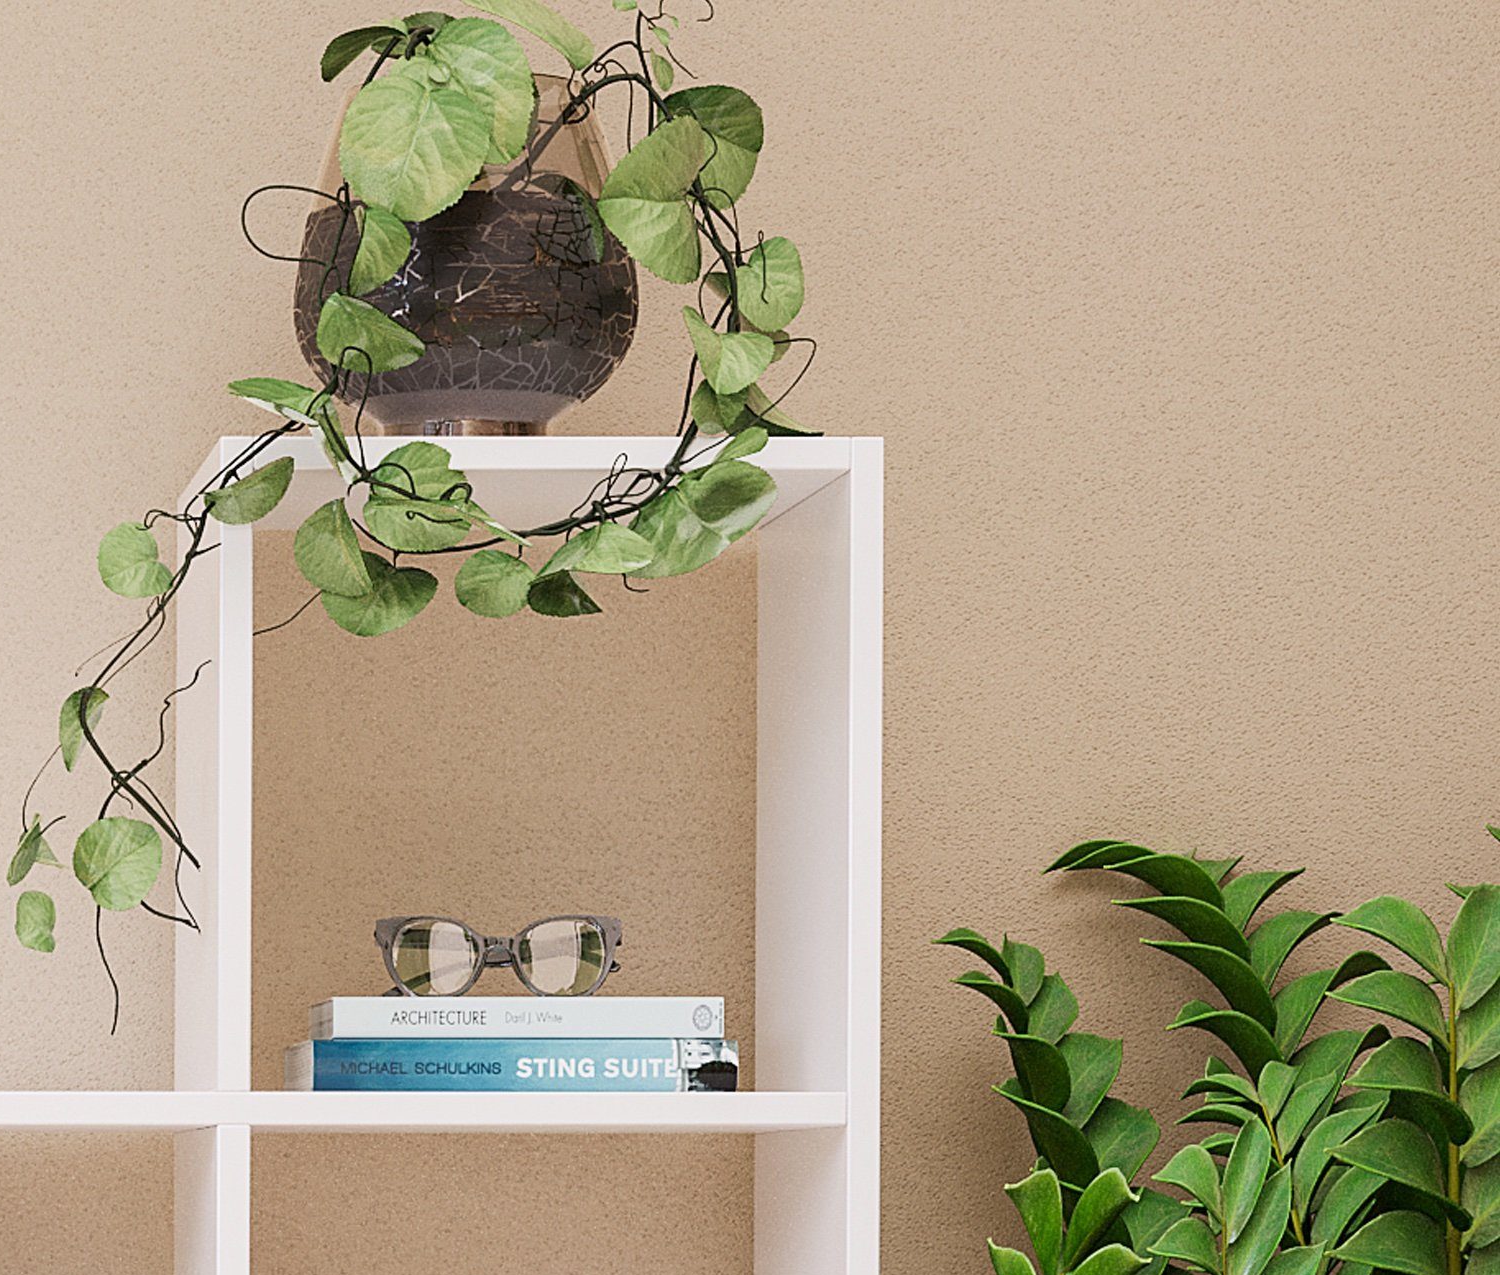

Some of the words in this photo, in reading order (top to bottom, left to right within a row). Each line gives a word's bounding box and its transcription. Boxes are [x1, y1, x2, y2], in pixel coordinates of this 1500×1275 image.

[391, 1010, 488, 1026] ARCHITECTURE
[339, 1061, 408, 1075] MICHAEL
[414, 1061, 502, 1076] SCHULKINS
[515, 1057, 595, 1079] STING
[602, 1057, 677, 1079] SUITE
